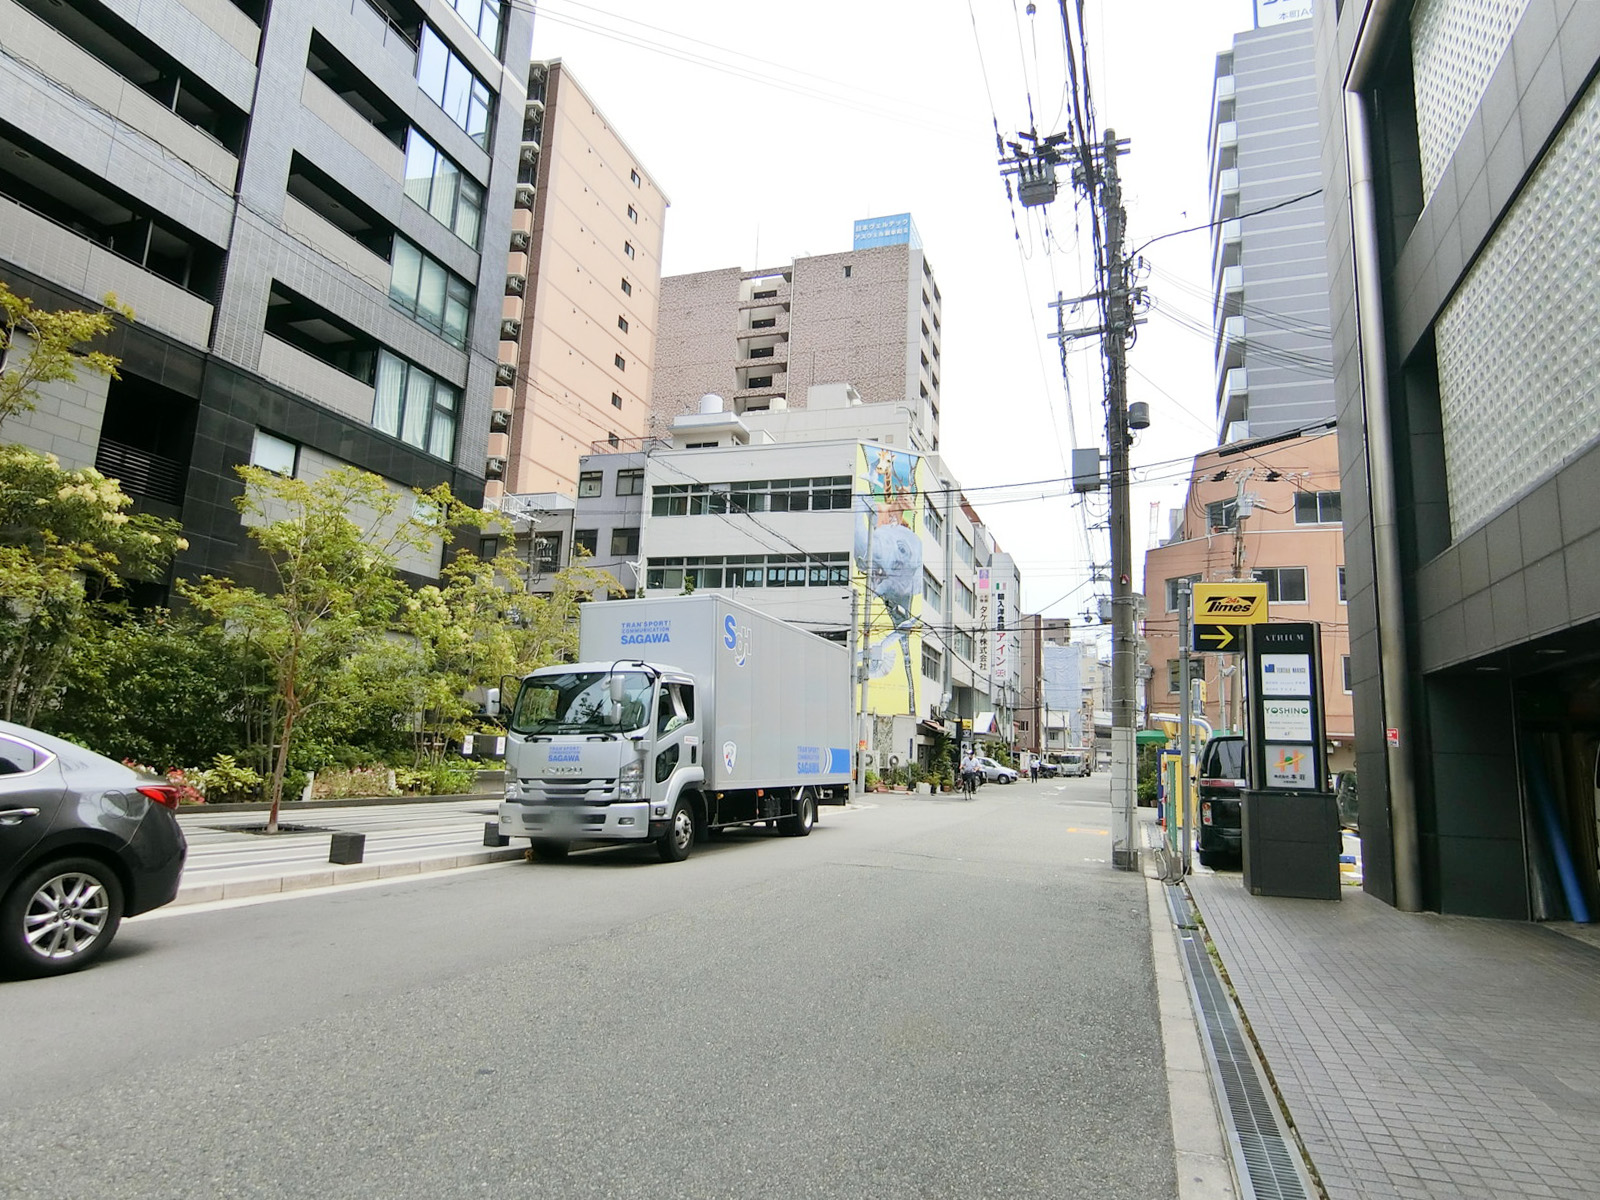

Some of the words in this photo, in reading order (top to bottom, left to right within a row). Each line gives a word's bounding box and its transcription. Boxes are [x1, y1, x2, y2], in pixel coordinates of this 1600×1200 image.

[1205, 598, 1253, 613] Times
[621, 633, 671, 645] SAGAWA
[1265, 633, 1304, 641] ATRIUM
[1265, 707, 1309, 715] YOSHINO
[548, 754, 580, 762] SAGAWA
[797, 762, 820, 775] SAGAWA
